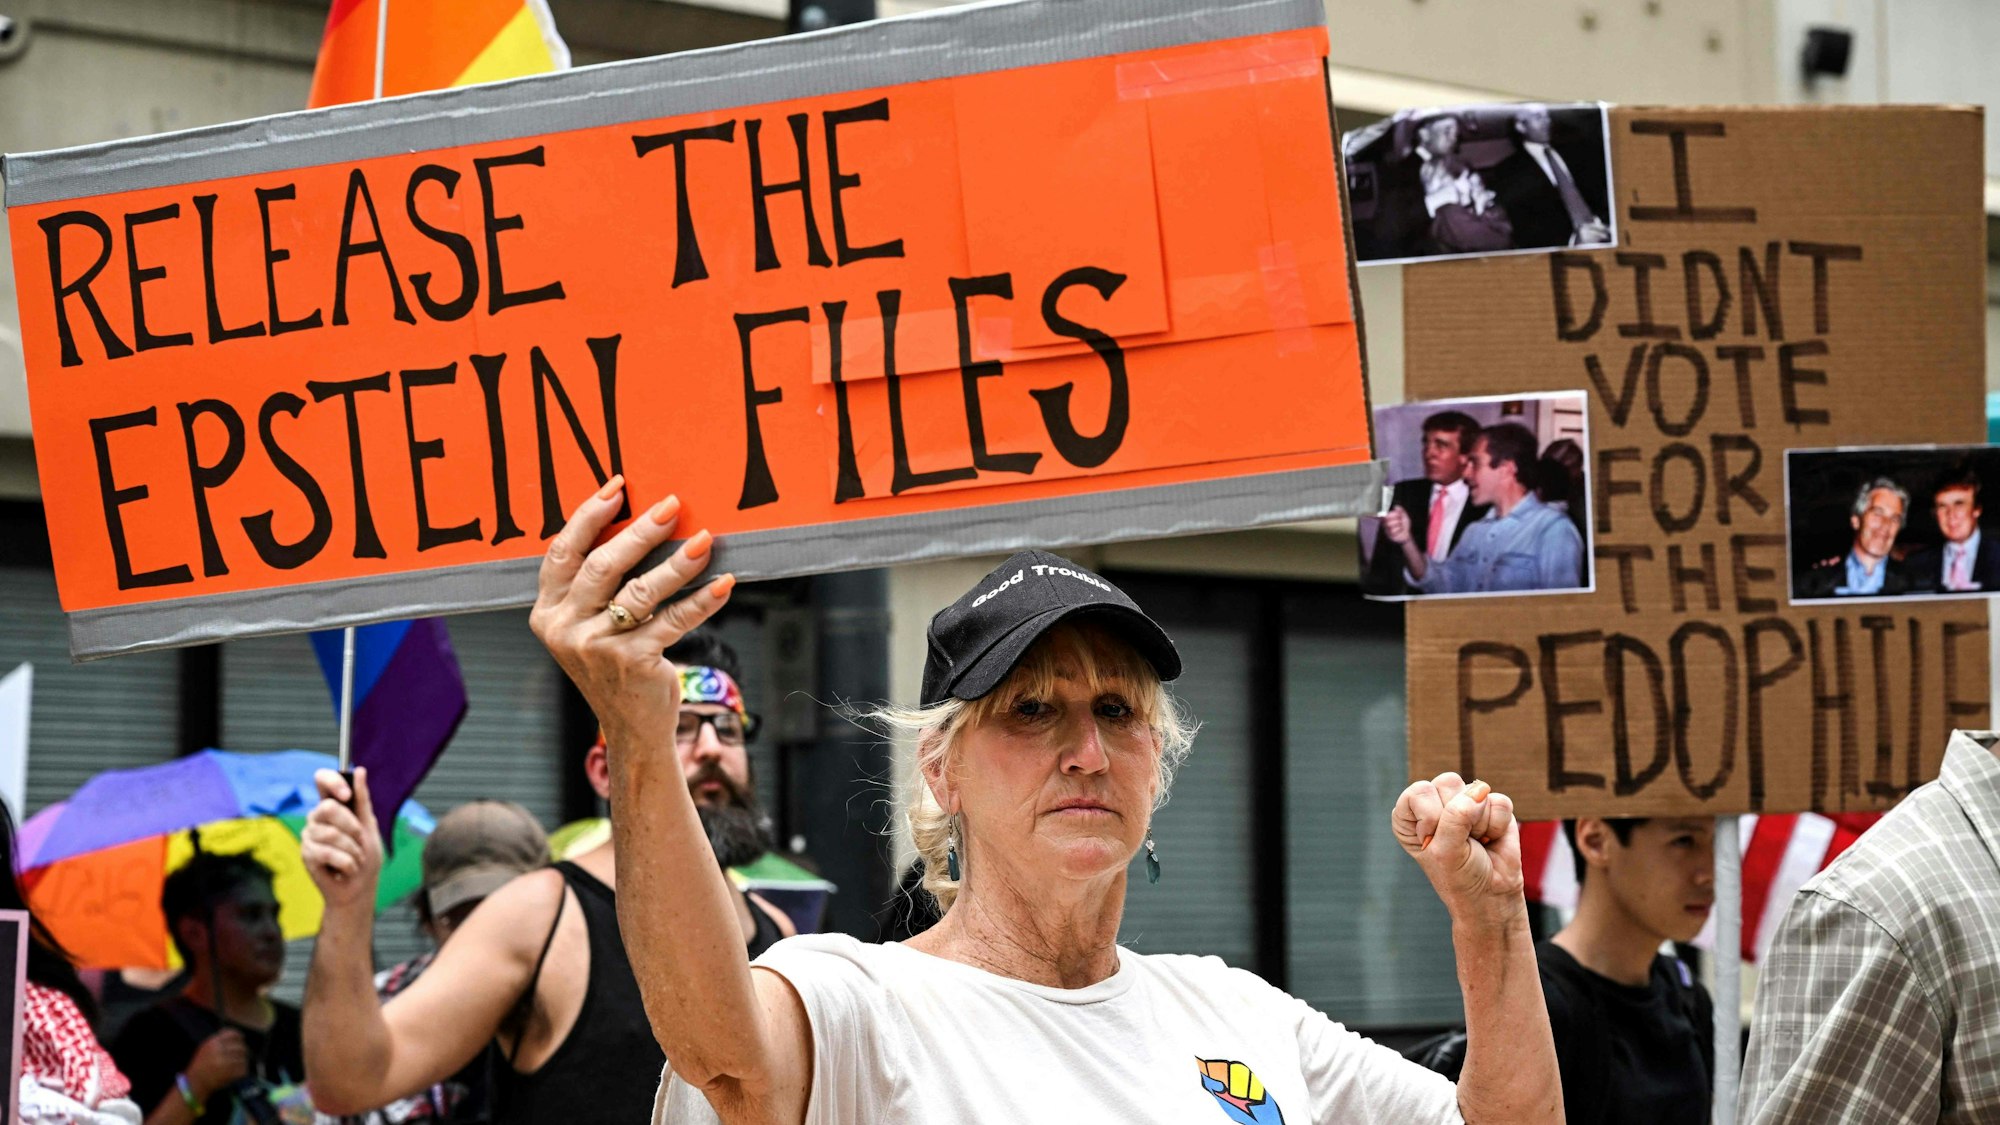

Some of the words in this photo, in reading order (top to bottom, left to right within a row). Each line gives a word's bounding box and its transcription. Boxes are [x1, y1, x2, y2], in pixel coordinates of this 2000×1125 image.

[1630, 120, 1757, 223] I
[38, 145, 566, 367] RELEASE
[632, 97, 905, 289] THE
[1550, 241, 1863, 342] DIDNT
[89, 333, 631, 590] EPSTEIN
[733, 266, 1130, 511] FILES
[1584, 340, 1831, 436] VOTE
[1597, 434, 1770, 536] FOR
[972, 569, 1024, 608] Good
[1031, 564, 1112, 593] Trouble
[1594, 534, 1788, 614] THE
